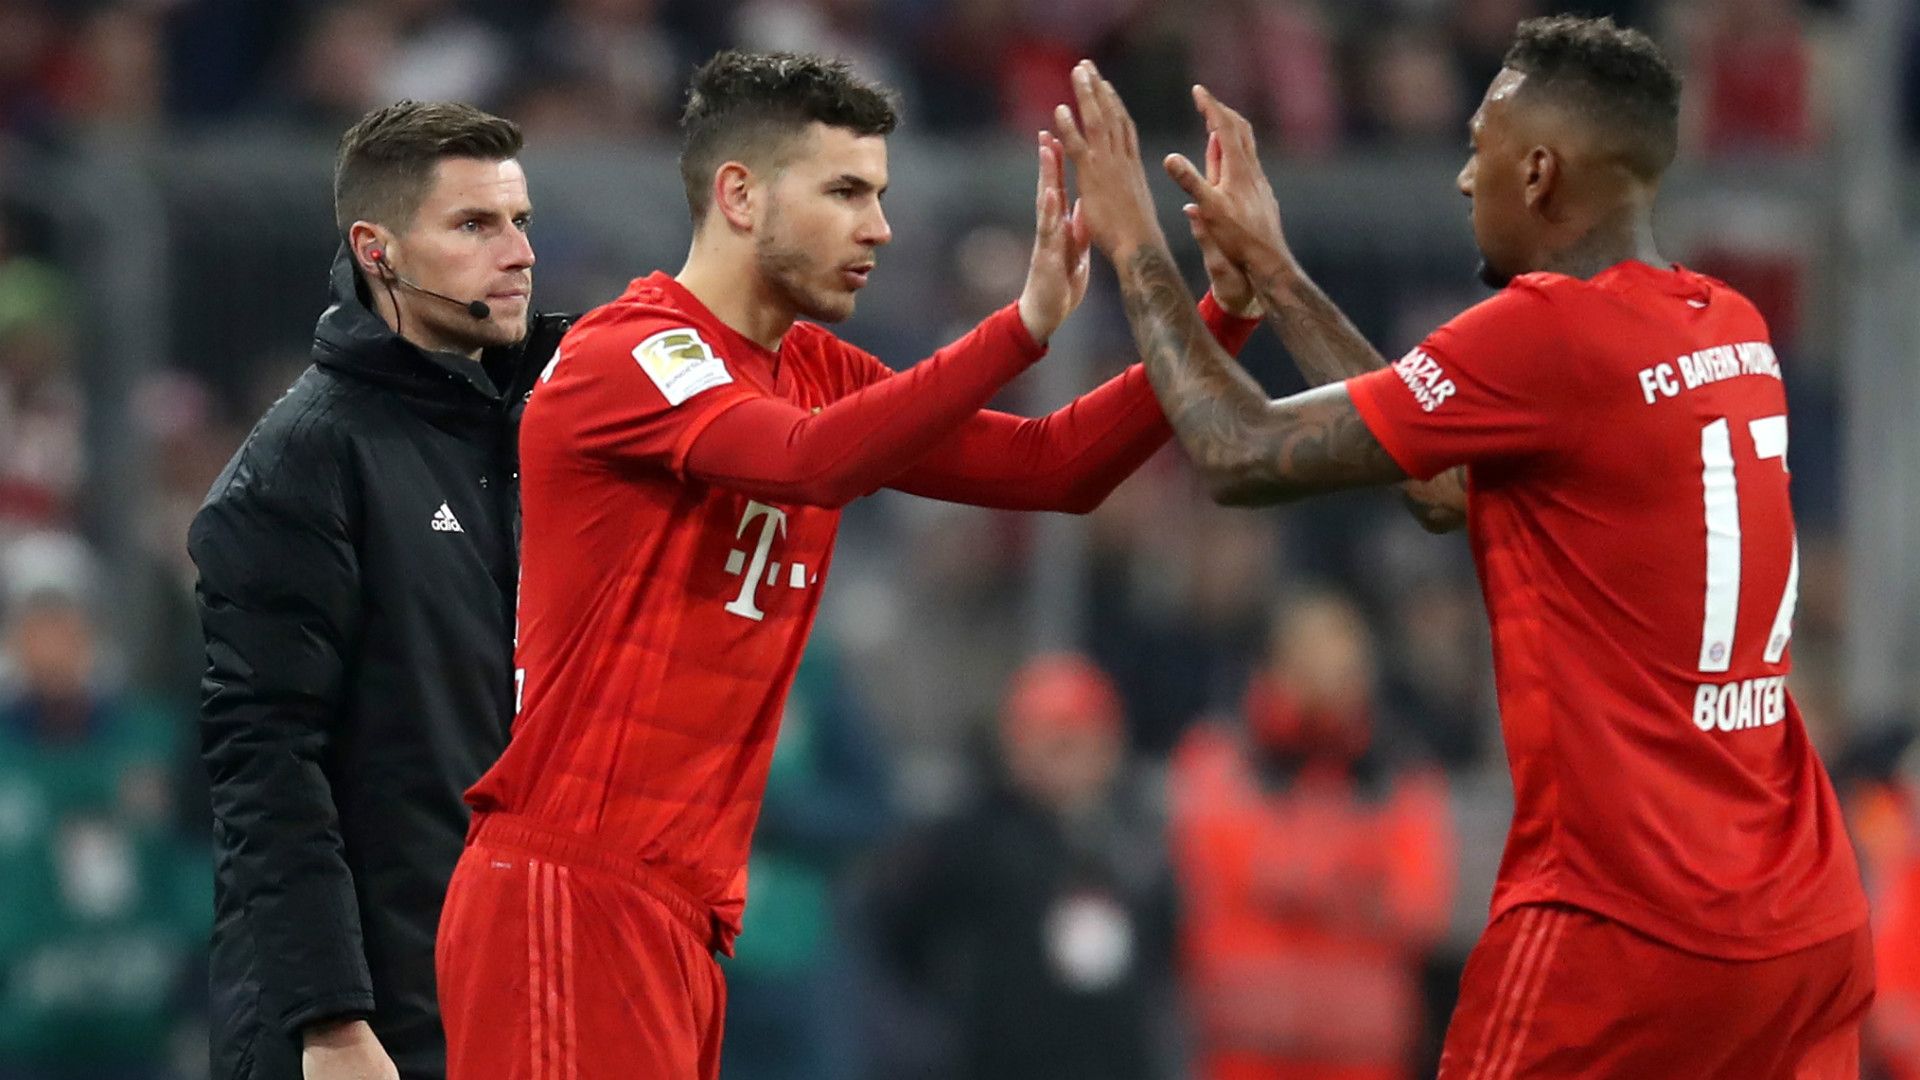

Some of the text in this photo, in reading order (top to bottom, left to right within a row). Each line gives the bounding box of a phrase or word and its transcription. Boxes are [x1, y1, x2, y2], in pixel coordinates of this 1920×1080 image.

[1638, 362, 1680, 405] FC
[1677, 345, 1741, 390] BAYERN
[431, 517, 465, 533] adid
[1698, 414, 1799, 673] 17
